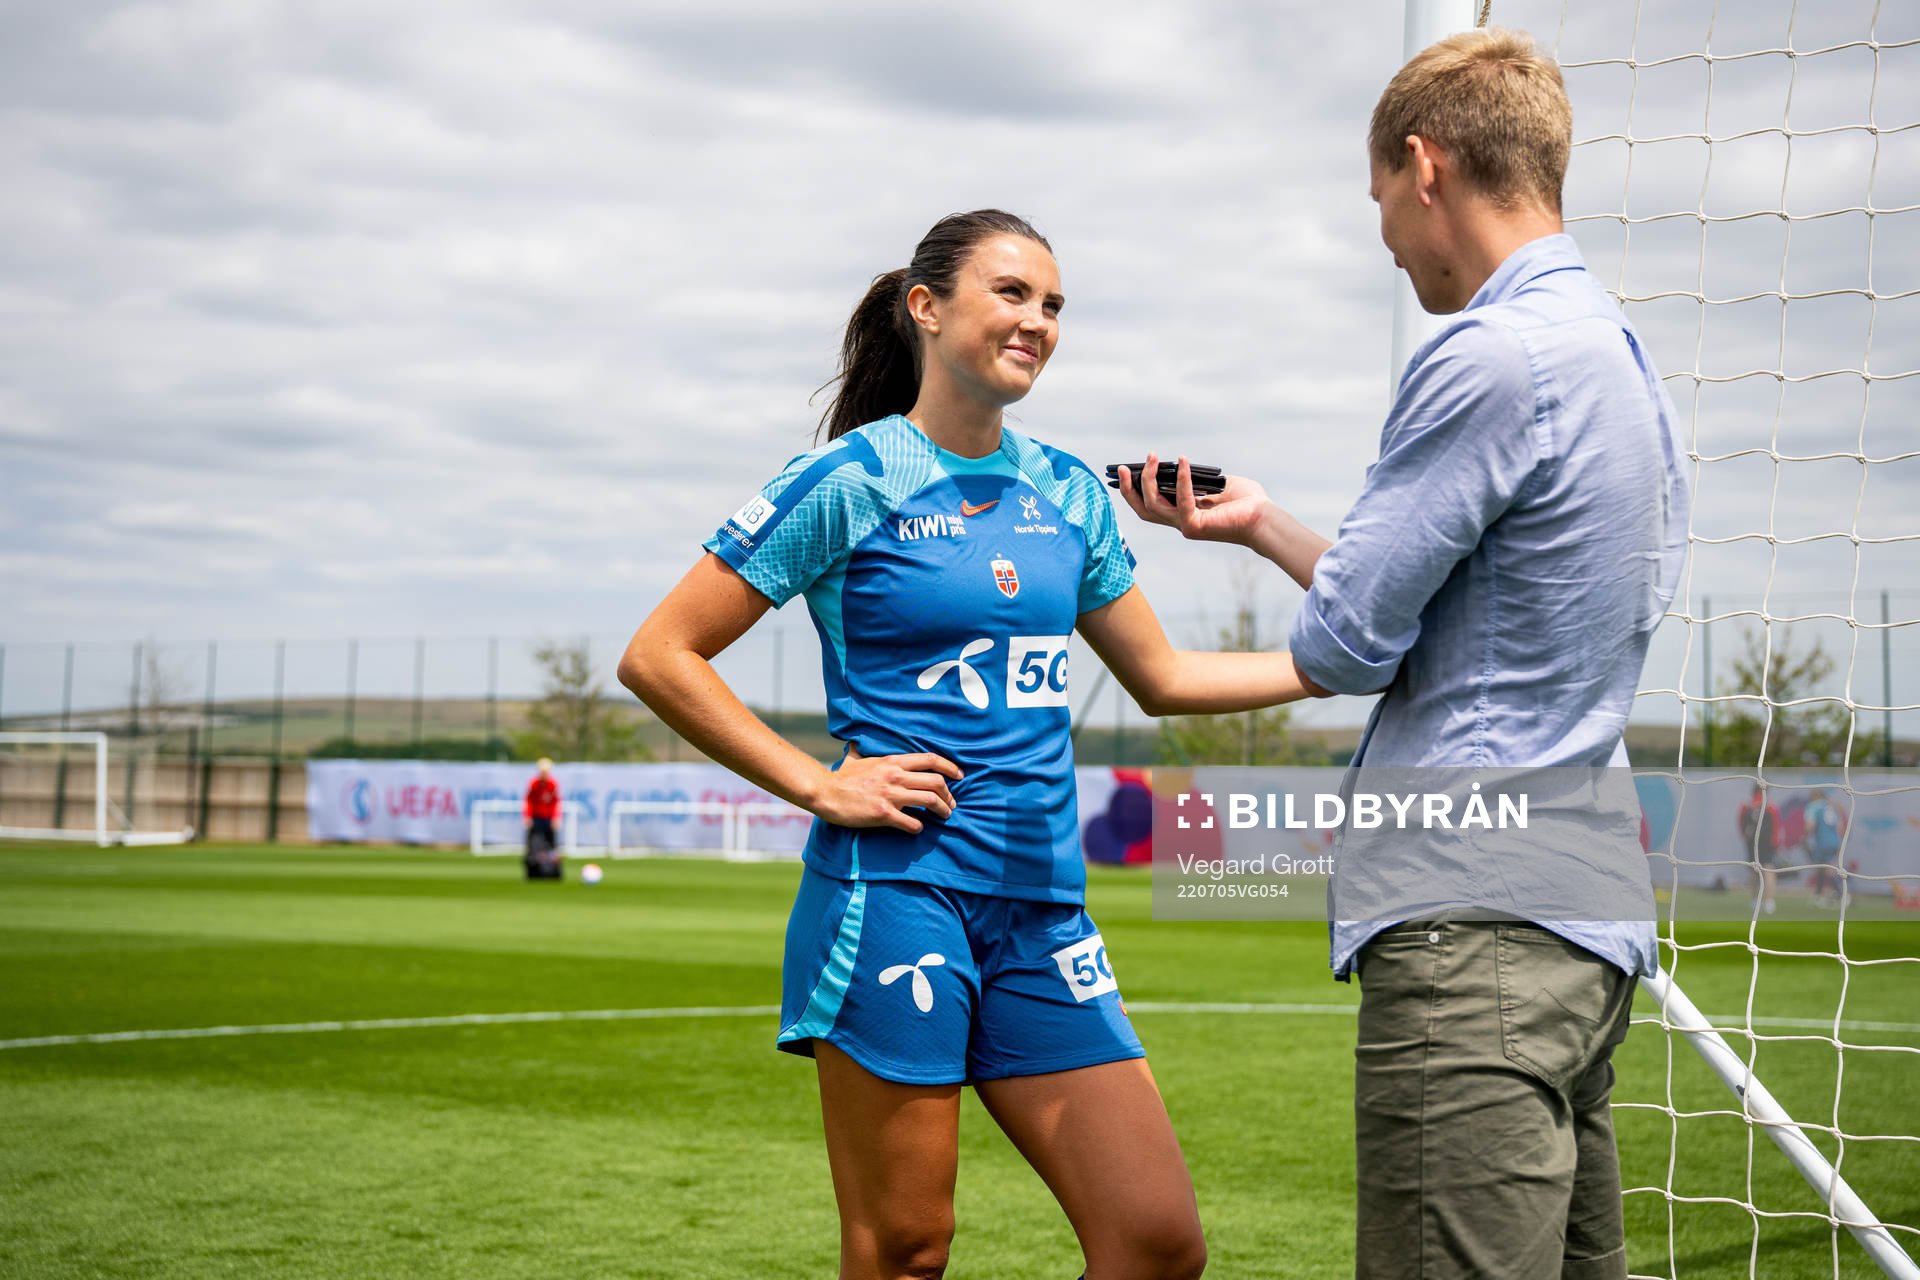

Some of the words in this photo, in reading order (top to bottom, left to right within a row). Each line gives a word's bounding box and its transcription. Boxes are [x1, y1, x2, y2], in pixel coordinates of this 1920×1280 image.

[899, 515, 948, 541] KIWI
[950, 525, 967, 537] pris
[1013, 524, 1035, 534] Norsk
[1034, 523, 1058, 535] Tipping
[1015, 649, 1068, 694] 5G
[386, 784, 459, 819] UEFA
